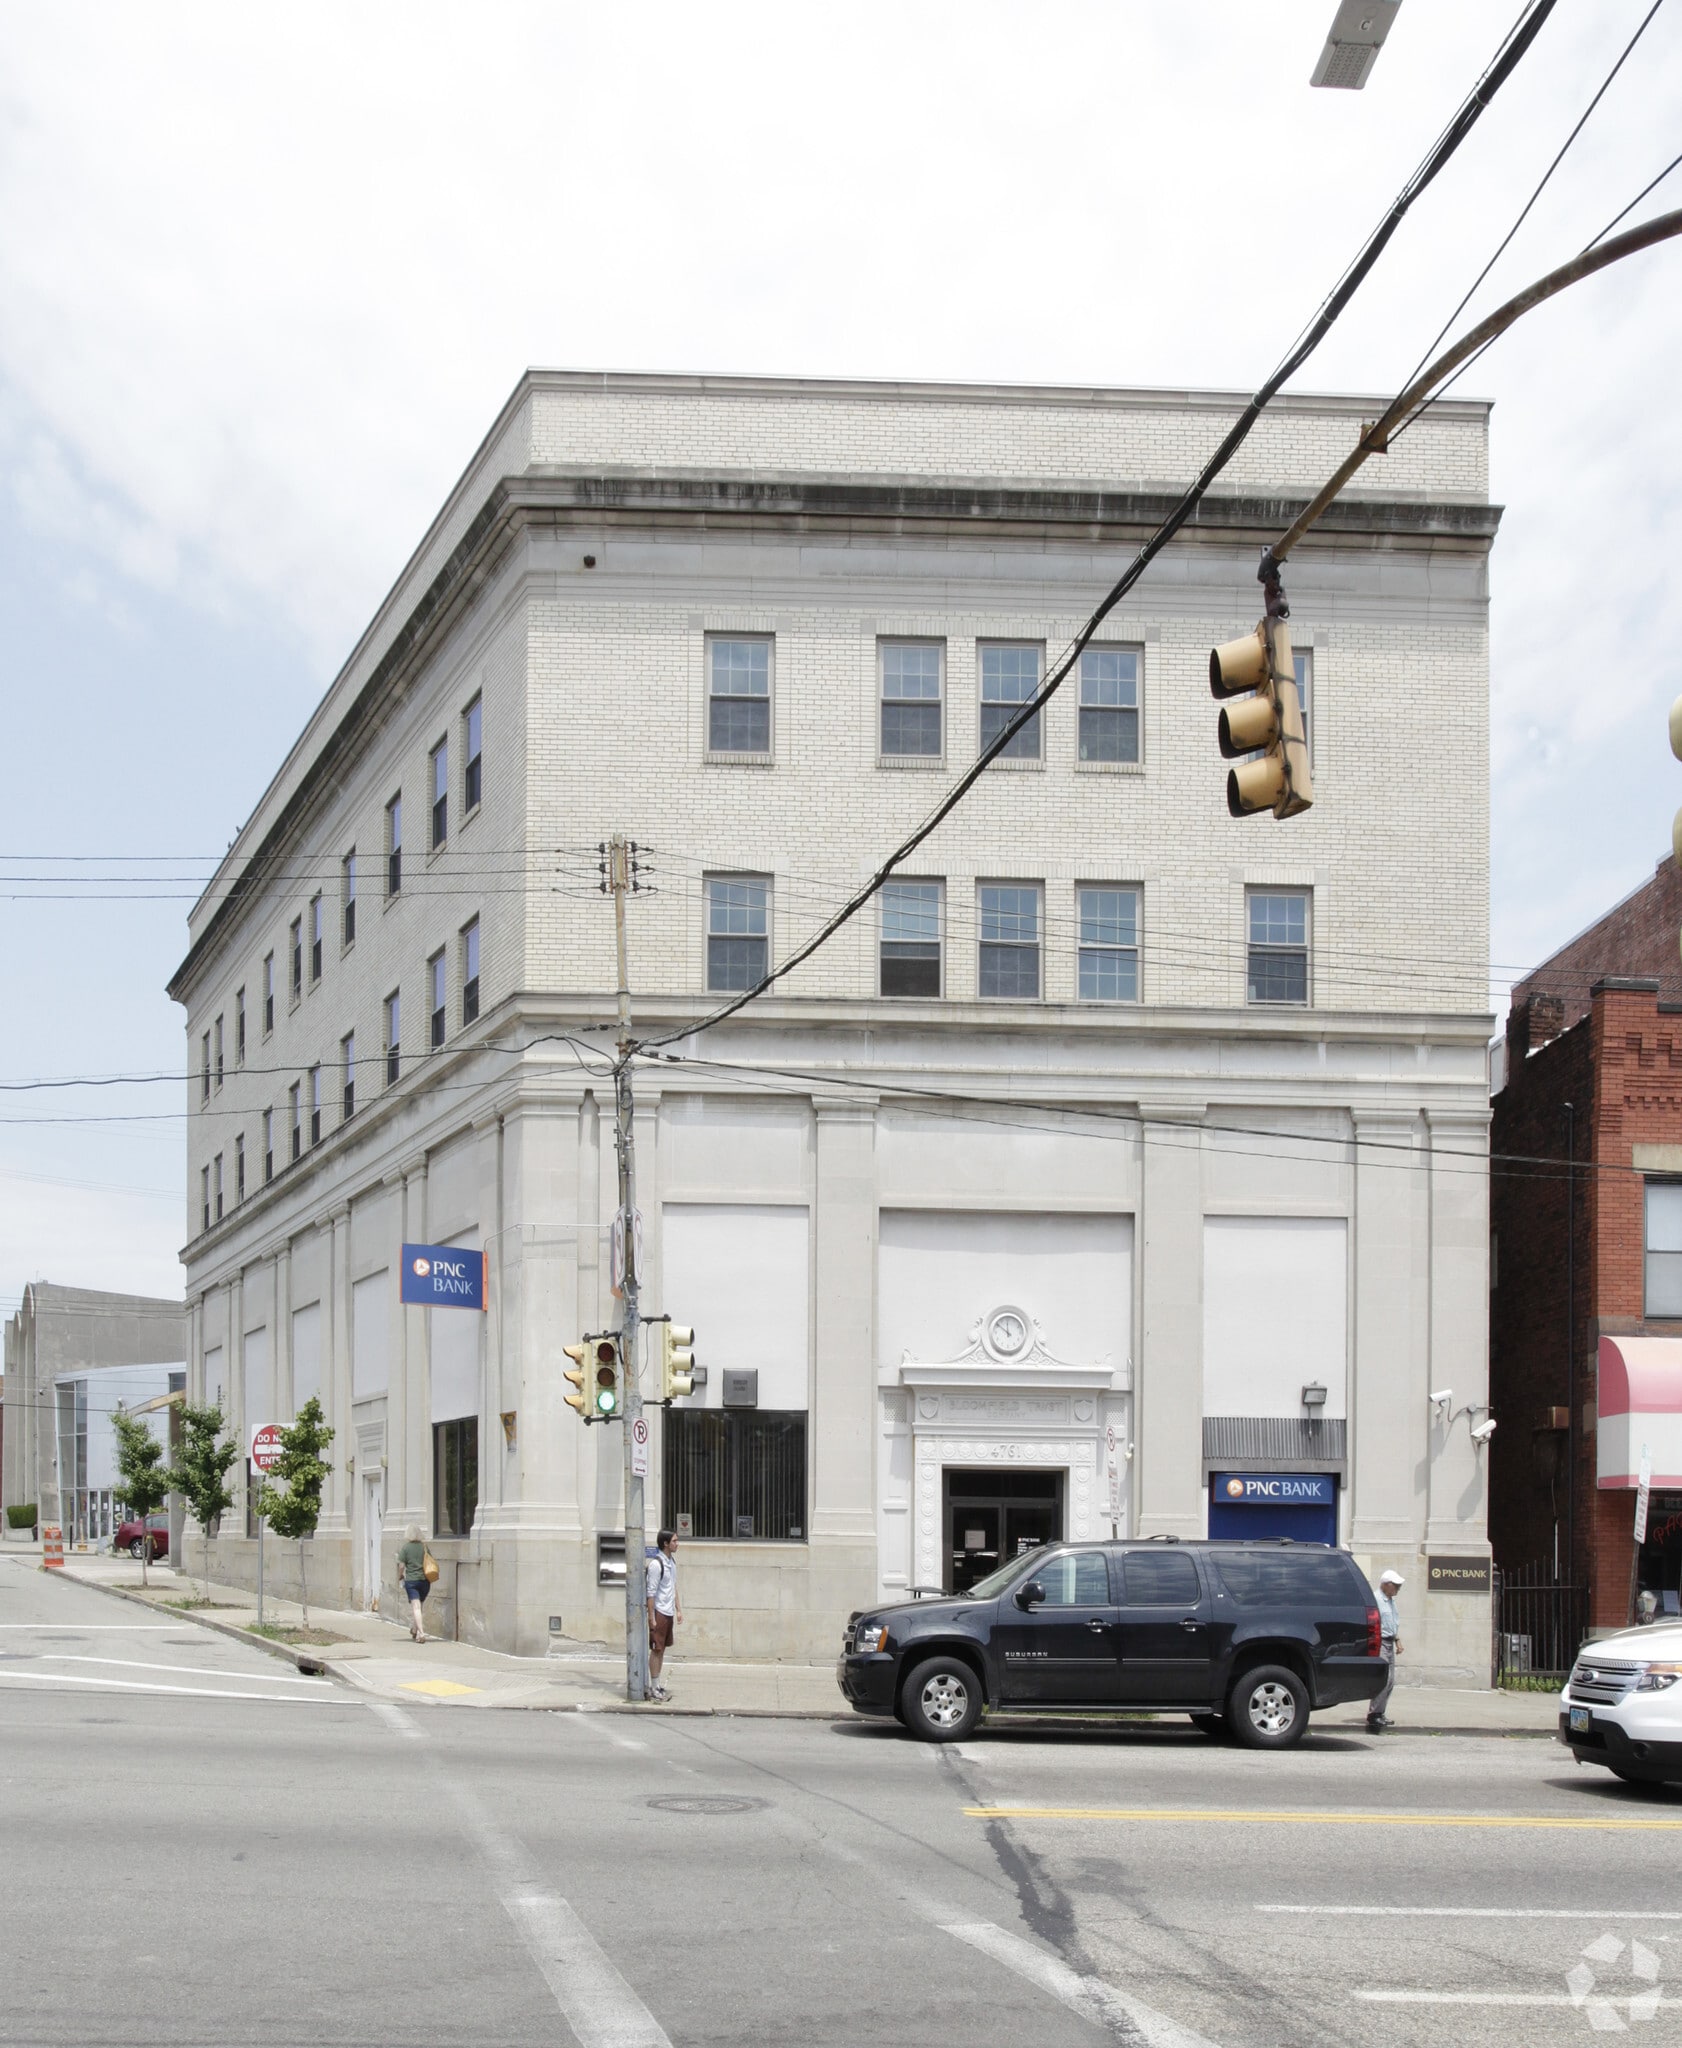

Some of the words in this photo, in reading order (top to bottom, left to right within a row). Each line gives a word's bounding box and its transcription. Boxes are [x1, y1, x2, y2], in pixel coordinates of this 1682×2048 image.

[432, 1260, 466, 1278] PNC
[432, 1277, 474, 1296] BANK
[949, 1400, 1020, 1411] BLOOMFIELD
[1026, 1400, 1064, 1413] TRUST
[257, 1434, 270, 1443] DO
[990, 1444, 1021, 1459] 4761
[260, 1456, 281, 1465] ENTE
[1245, 1481, 1281, 1496] PNC
[1281, 1482, 1322, 1497] BANK
[1442, 1569, 1462, 1578] PNC
[1462, 1569, 1487, 1578] BANK
